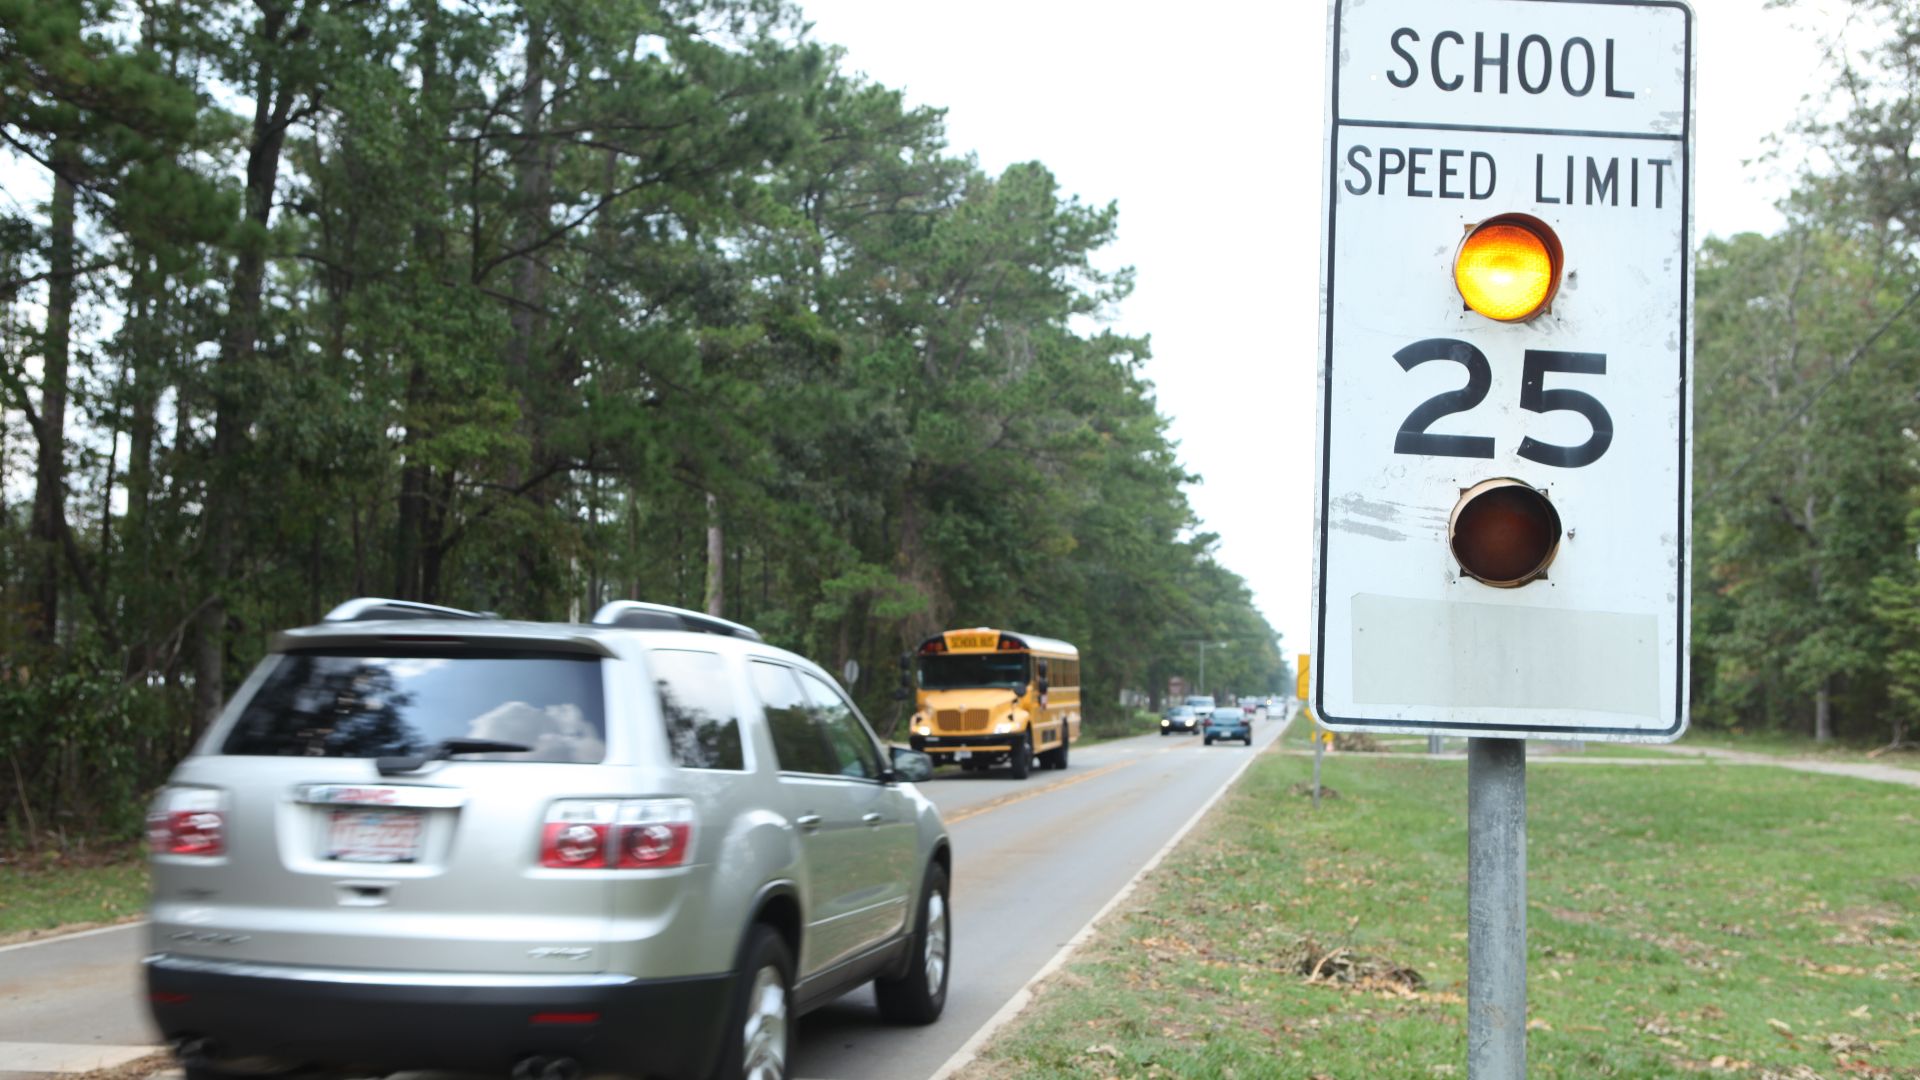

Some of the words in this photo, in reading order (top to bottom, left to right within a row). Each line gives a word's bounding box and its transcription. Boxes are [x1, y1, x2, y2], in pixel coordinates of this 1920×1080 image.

[1386, 27, 1635, 100] SCHOOL
[1344, 144, 1497, 201] SPEED
[1535, 153, 1673, 209] LIMIT
[1391, 337, 1614, 469] 25
